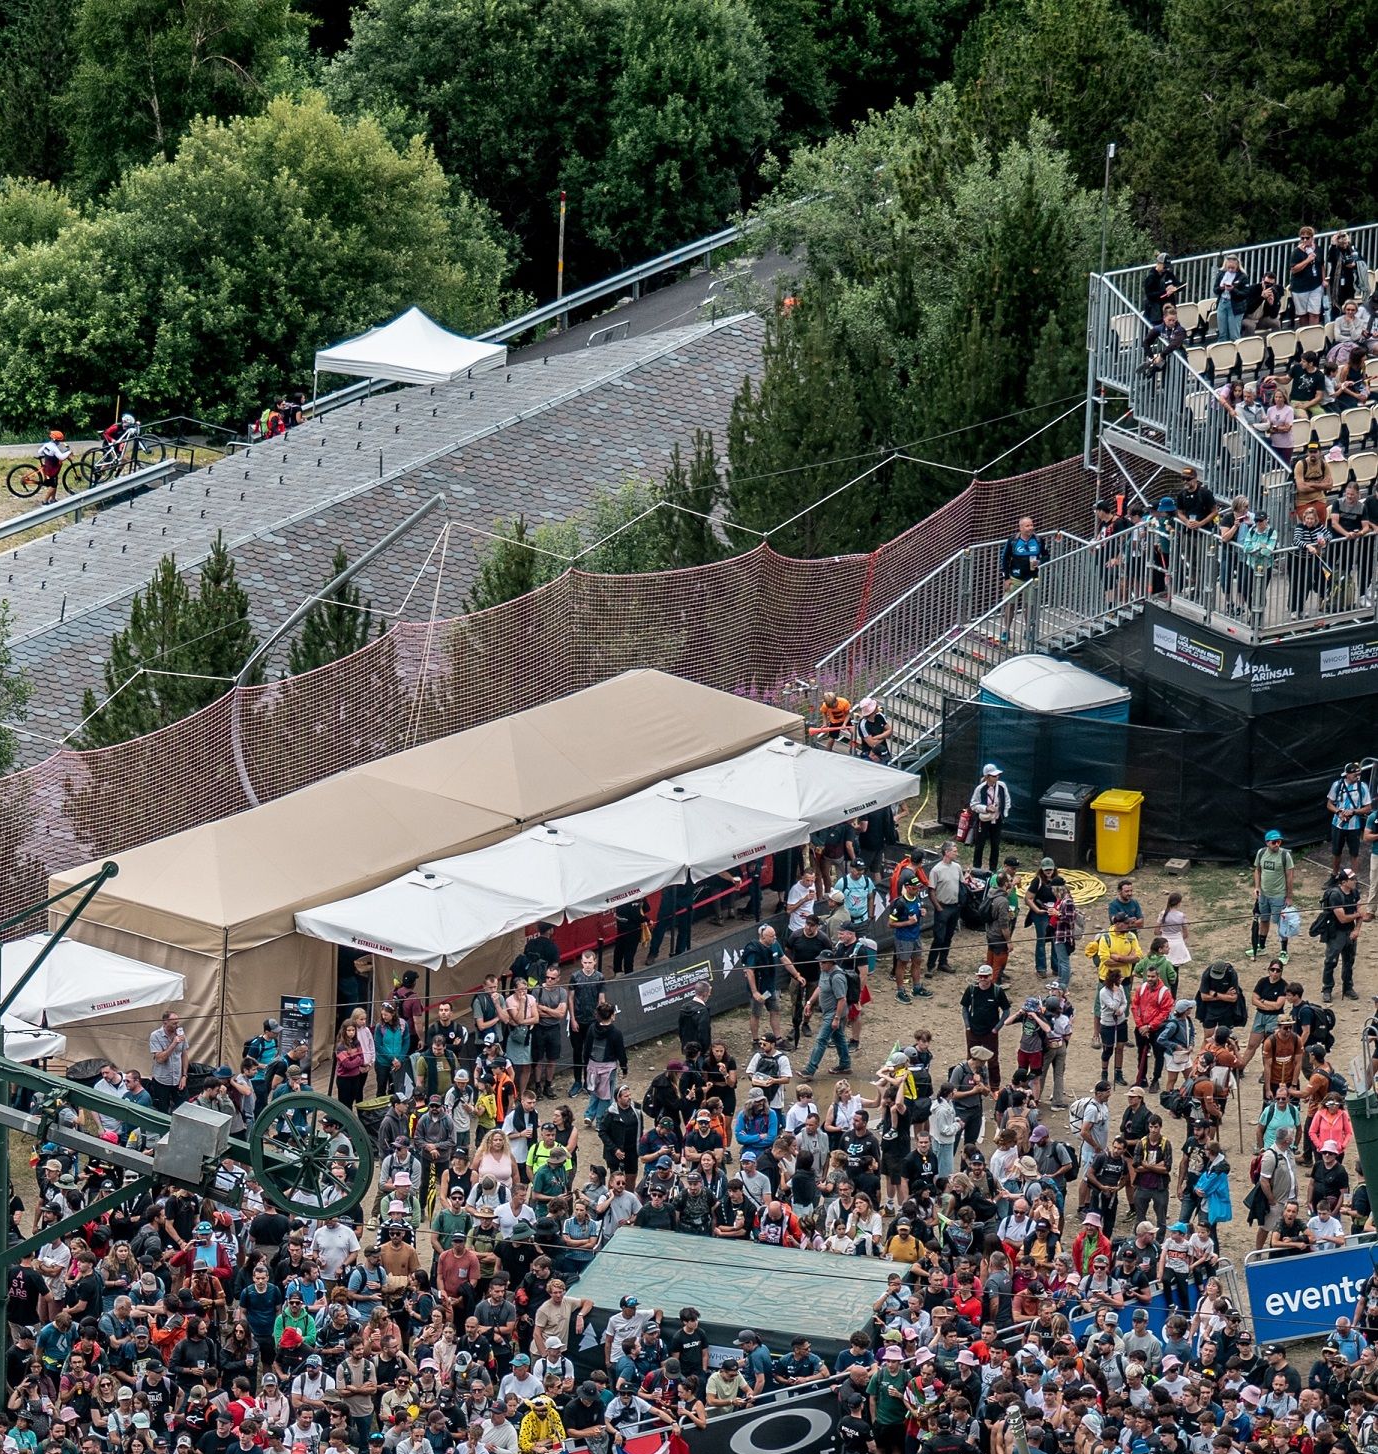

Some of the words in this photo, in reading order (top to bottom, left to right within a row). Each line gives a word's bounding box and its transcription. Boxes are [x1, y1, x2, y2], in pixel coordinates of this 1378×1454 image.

[1251, 664, 1271, 674] PAL
[1251, 667, 1295, 682] ARINSAL
[849, 804, 865, 814] ESTRELLA
[865, 800, 878, 809] DAMM
[737, 850, 754, 859] ESTRELLA
[754, 845, 767, 854] DAMM
[610, 892, 628, 903] ESTRELLA
[628, 888, 642, 897] DAMM
[357, 938, 379, 950] ESTRELLA
[379, 944, 393, 953] DAMM
[96, 1001, 116, 1010] ESTRELLA
[117, 998, 130, 1007] DAMM
